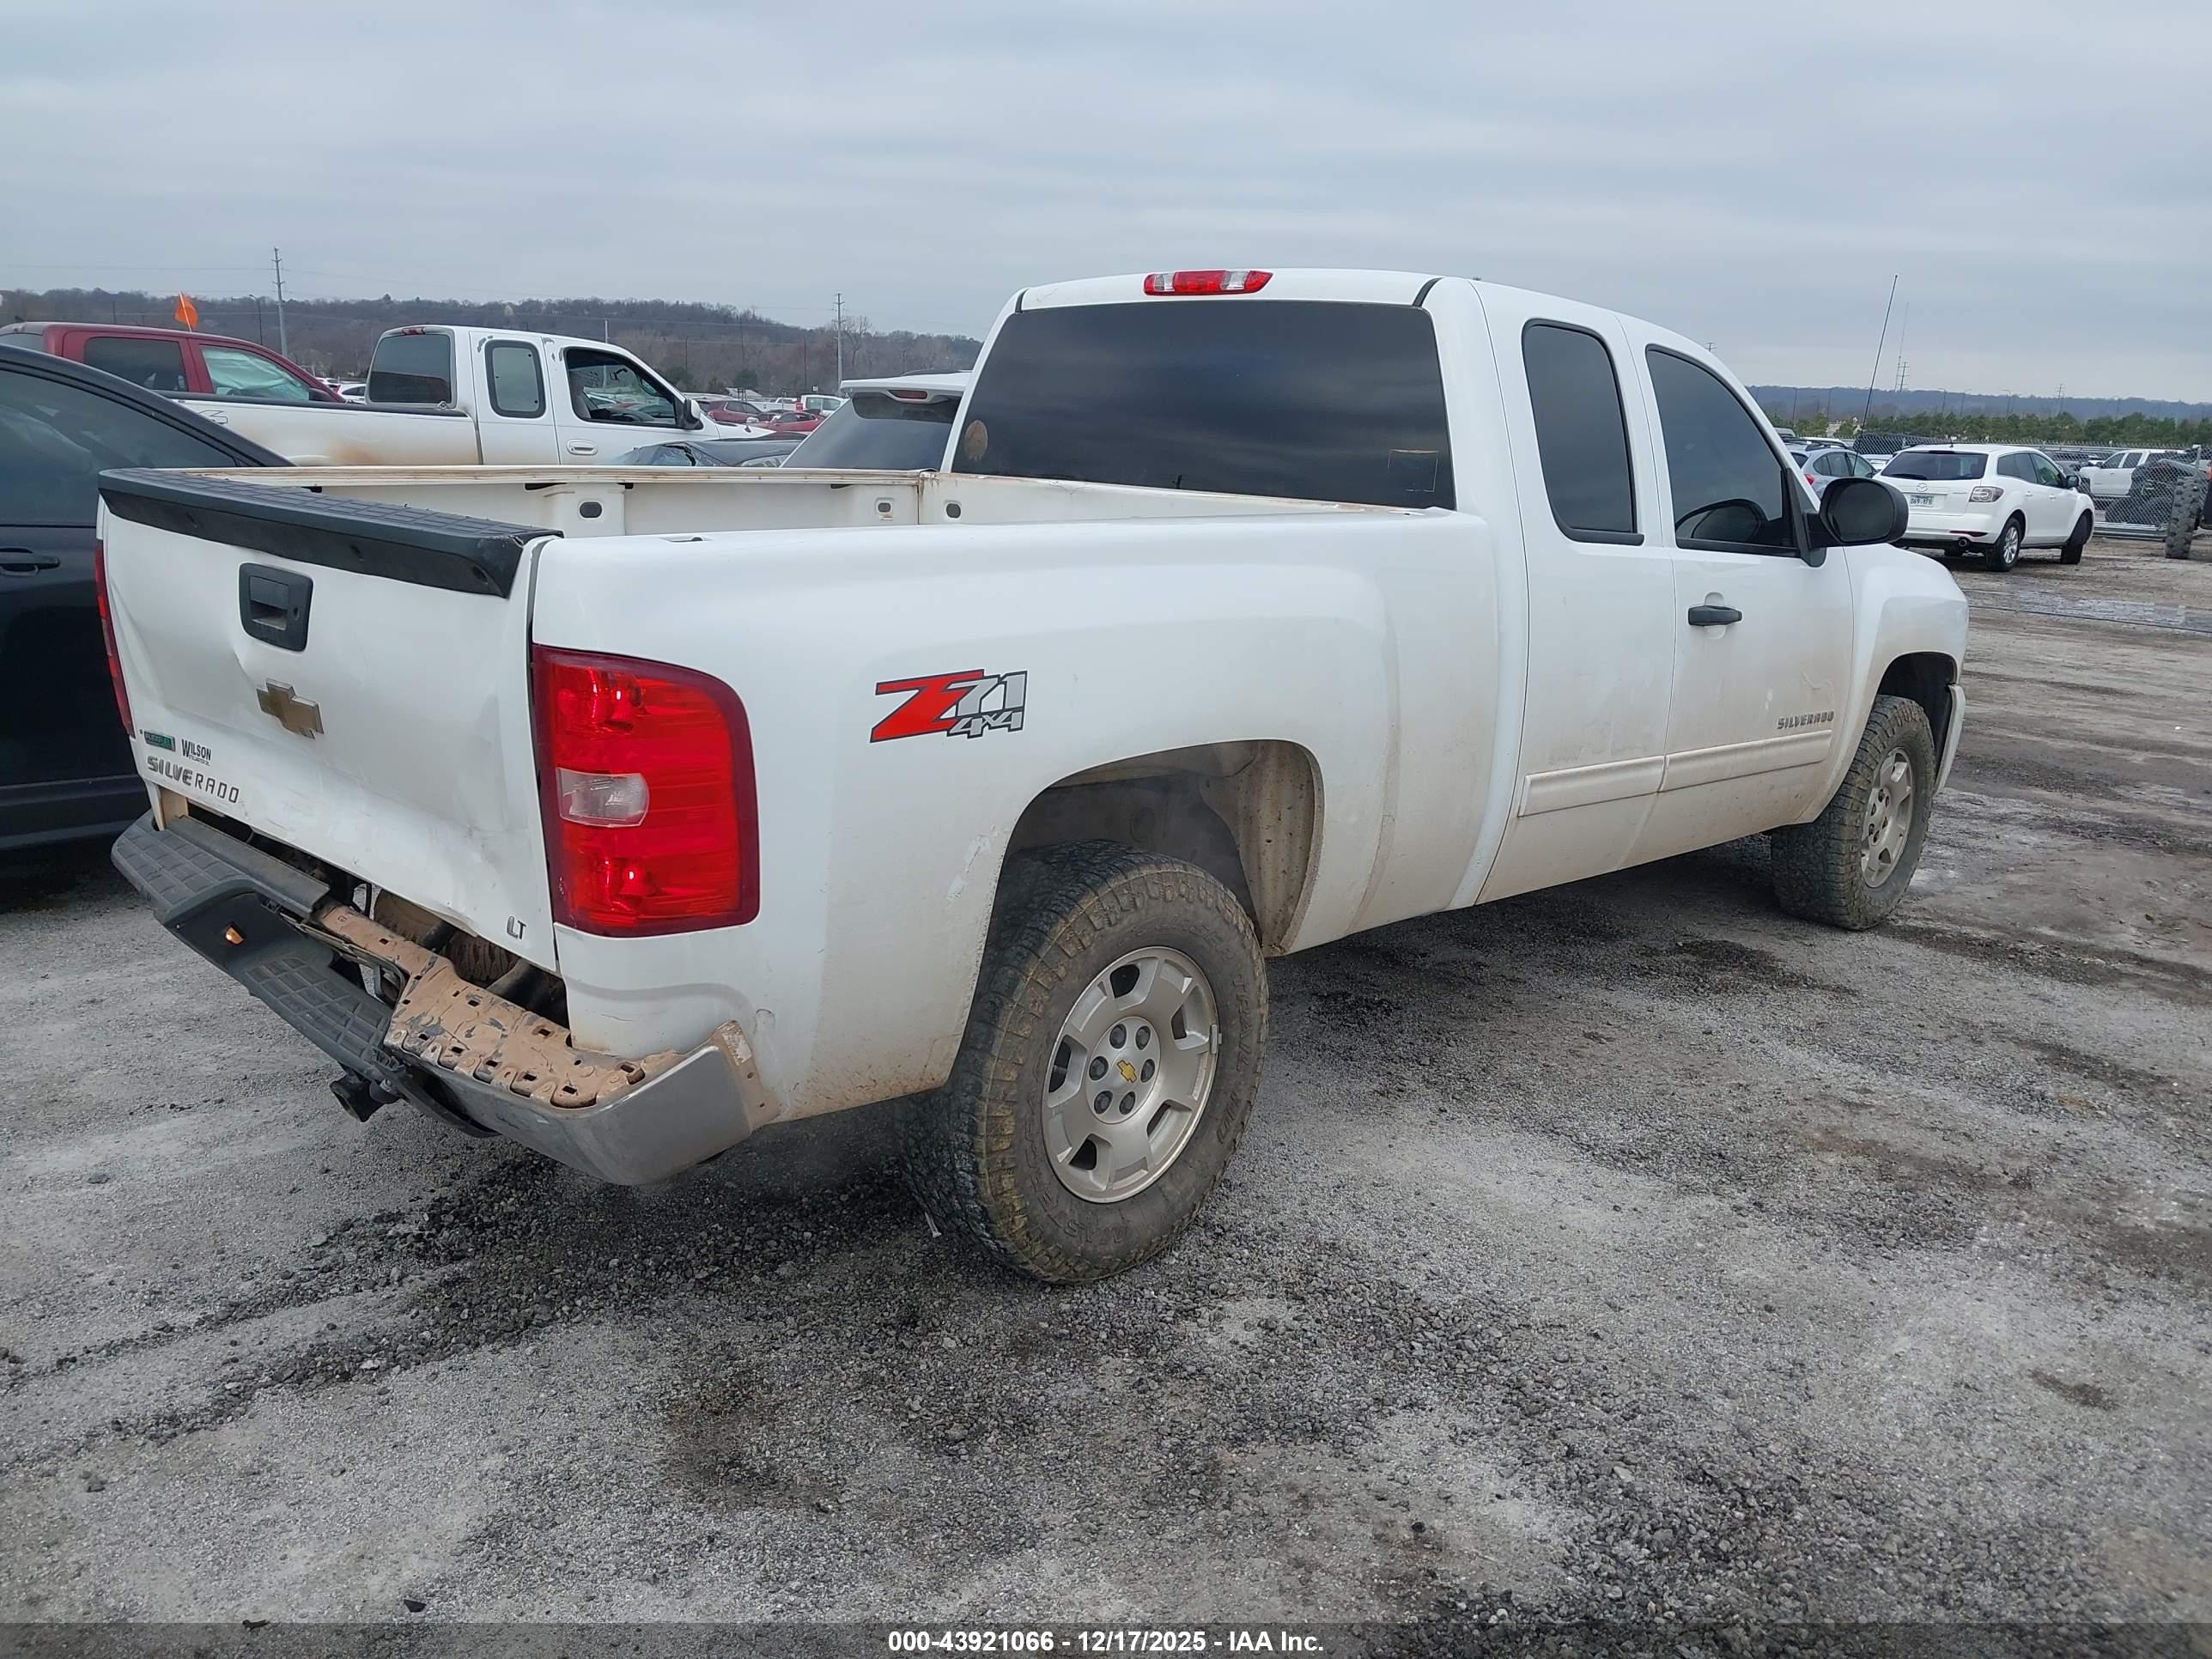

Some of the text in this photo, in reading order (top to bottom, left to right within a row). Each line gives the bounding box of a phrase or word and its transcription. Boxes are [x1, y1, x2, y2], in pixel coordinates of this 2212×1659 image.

[870, 669, 1027, 743] Z71
[1777, 711, 1835, 730] SILVERADO
[181, 738, 212, 761] WILSON
[147, 756, 240, 804] SILVERADO
[507, 915, 526, 940] LT
